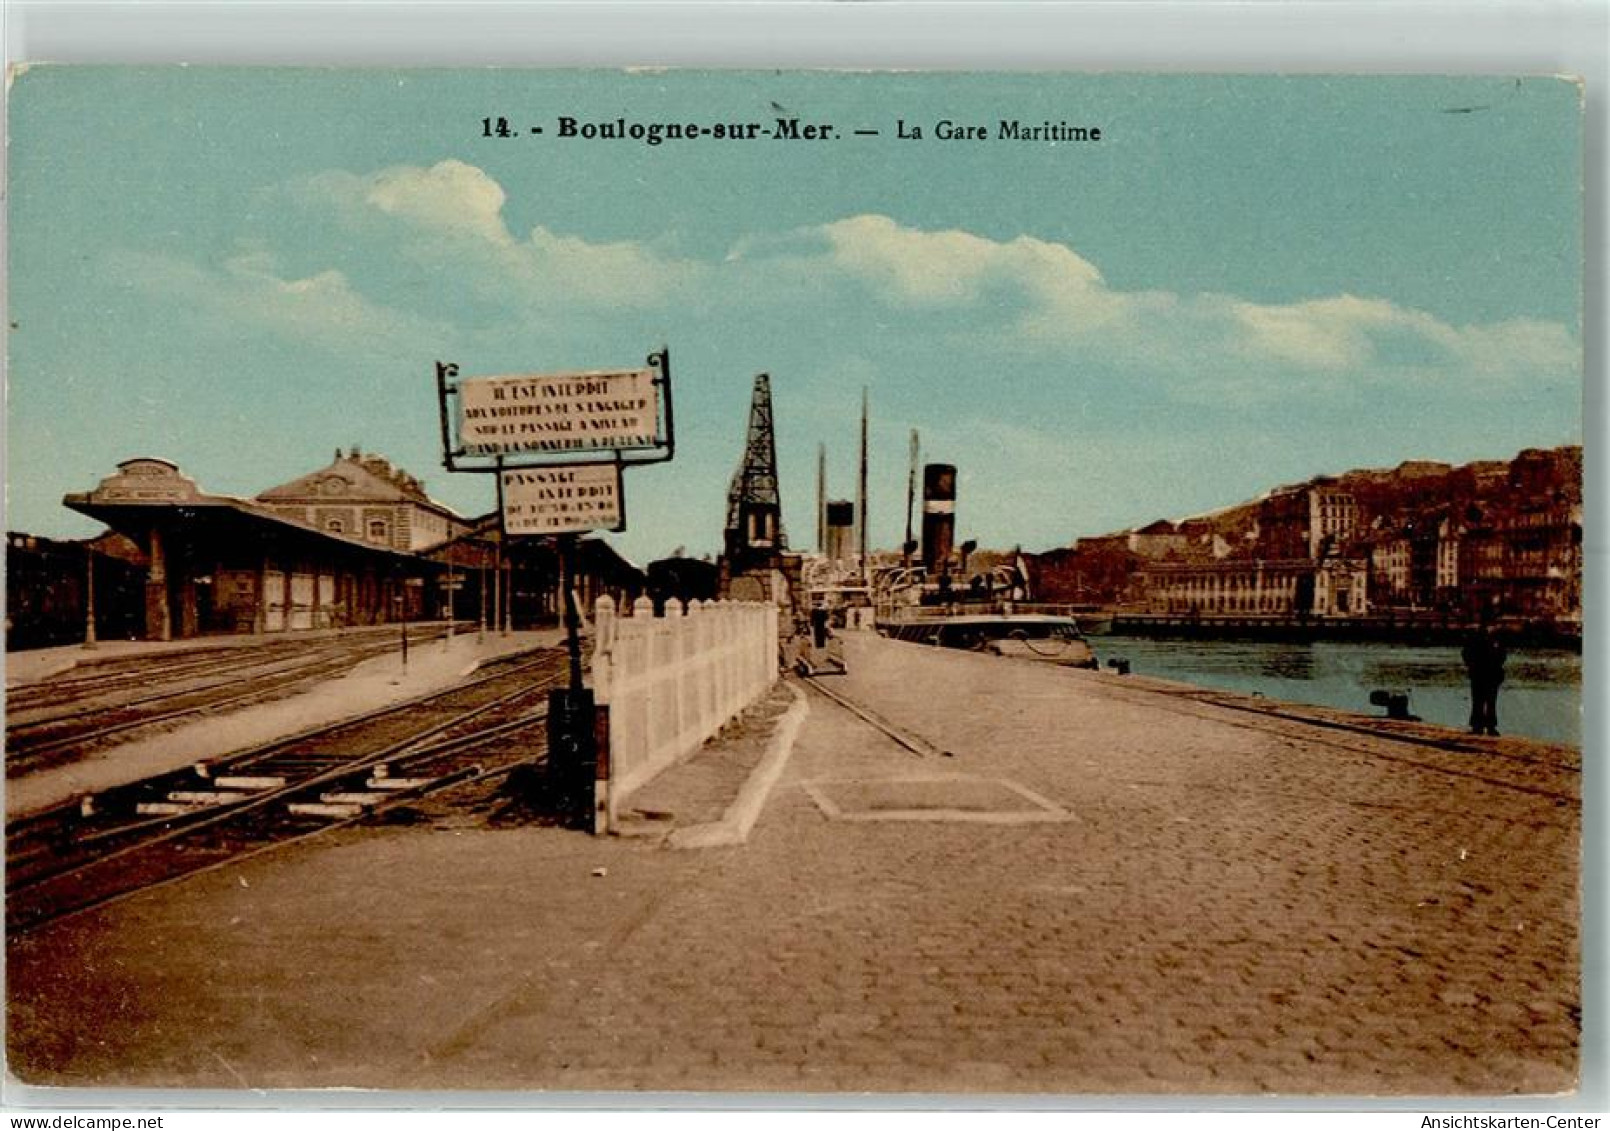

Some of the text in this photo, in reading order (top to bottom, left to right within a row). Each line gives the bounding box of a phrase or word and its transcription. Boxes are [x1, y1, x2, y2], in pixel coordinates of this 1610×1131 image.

[542, 381, 608, 398] INTERDIT
[520, 420, 572, 433] PASSAGE
[504, 472, 613, 499] PASSAGE INTERDIT
